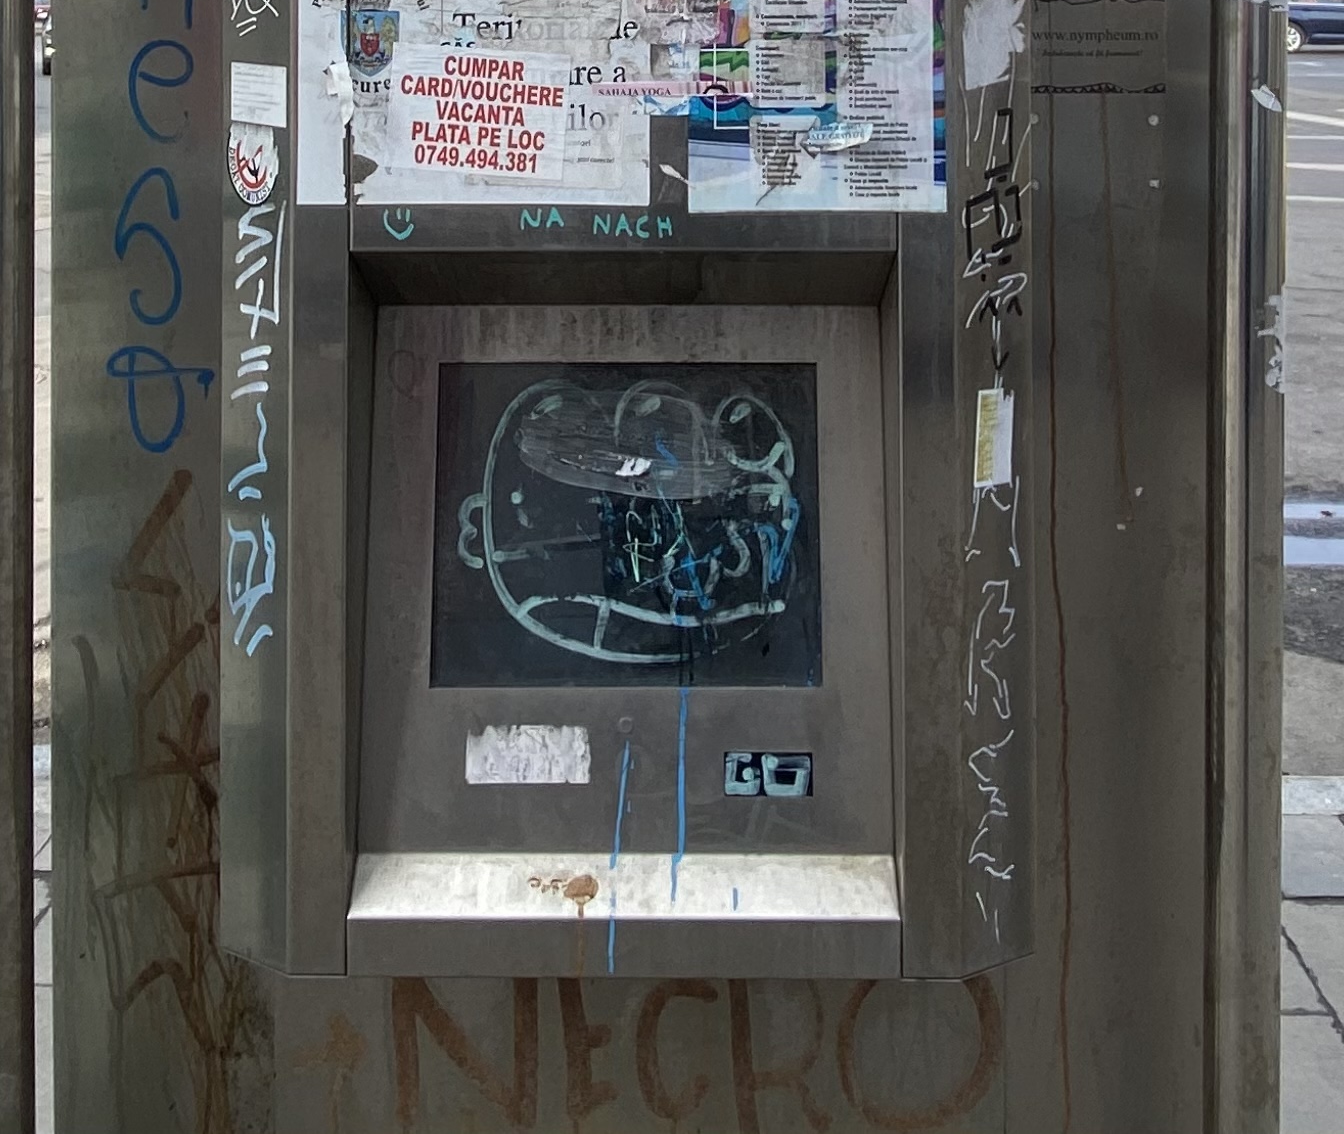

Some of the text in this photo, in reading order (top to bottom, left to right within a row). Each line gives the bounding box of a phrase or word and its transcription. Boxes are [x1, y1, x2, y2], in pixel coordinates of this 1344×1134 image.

[1032, 28, 1160, 45] www.nympheum.ro
[444, 55, 525, 82] CUMPAR
[613, 65, 627, 85] a
[401, 75, 565, 107] CARD/VOUCHERE
[640, 87, 672, 97] YOGA
[436, 100, 525, 127] VACANTA
[411, 121, 545, 152] PLATA PE LOC
[414, 145, 538, 174] 0749.494.381
[520, 207, 673, 239] NA NACH
